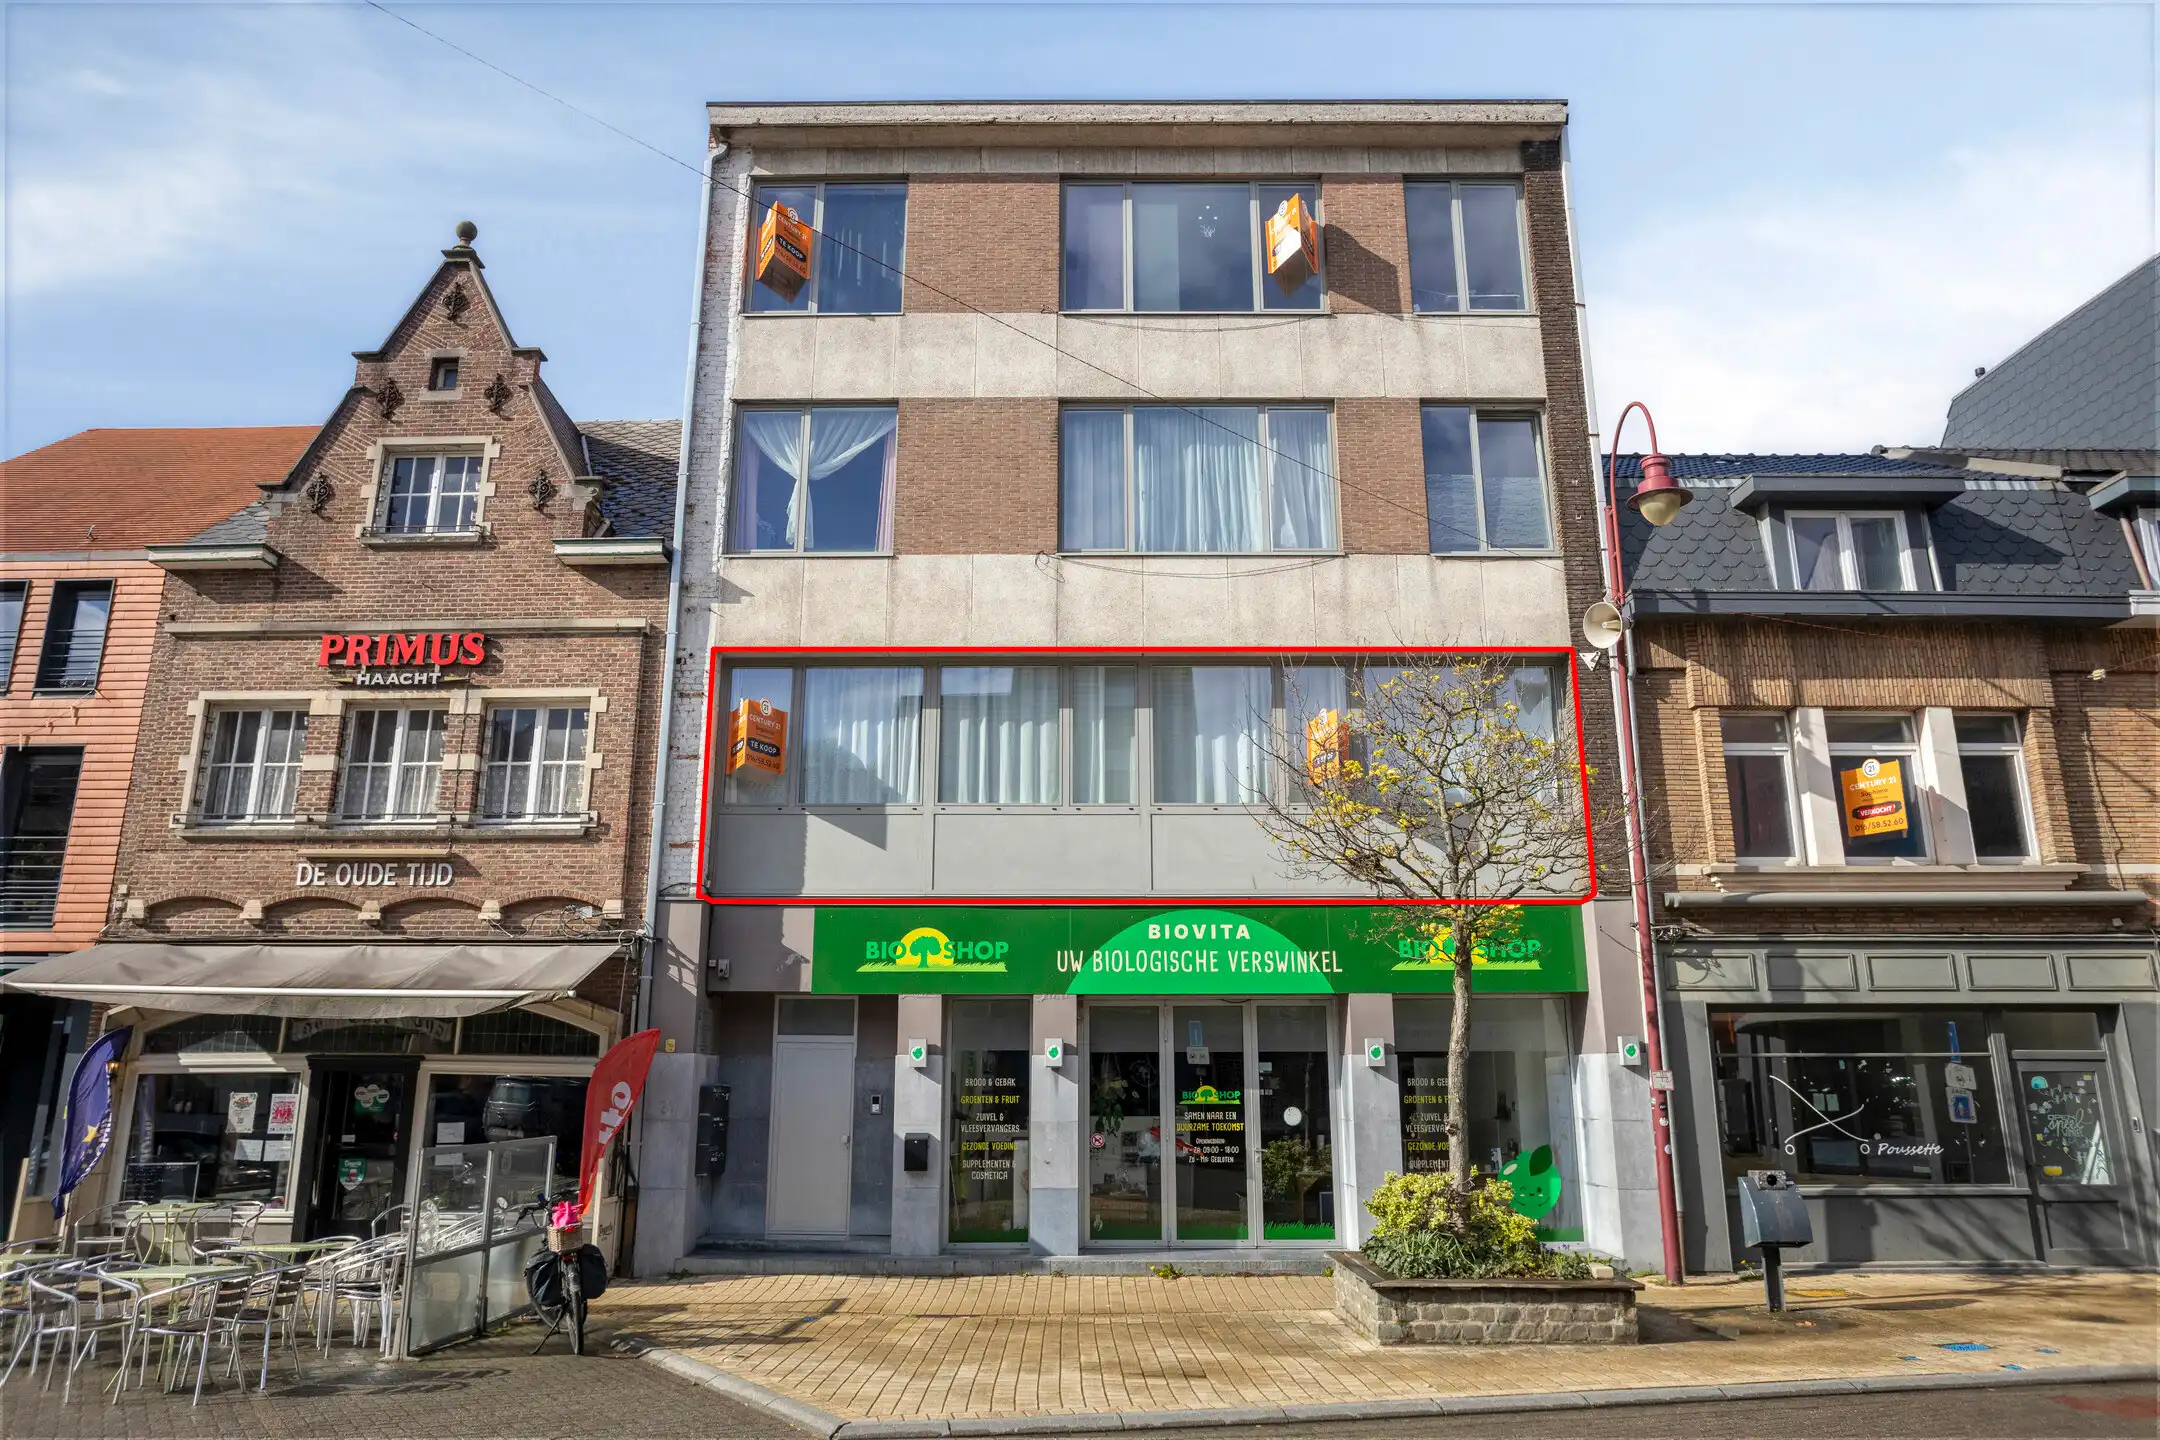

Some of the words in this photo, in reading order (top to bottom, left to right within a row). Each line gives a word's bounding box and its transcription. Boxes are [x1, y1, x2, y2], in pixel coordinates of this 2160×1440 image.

[780, 238, 786, 248] TE
[788, 244, 804, 259] KOOP
[316, 632, 487, 667] PRIMUS
[356, 672, 442, 686] HAACHT
[749, 714, 775, 729] CENTURY
[750, 740, 758, 749] TE
[760, 744, 777, 754] KOOP
[1849, 778, 1887, 791] CENTURY
[1888, 776, 1897, 785] 21
[1860, 805, 1893, 817] VERKOCHT
[1854, 817, 1904, 832] 016/58.52.60
[296, 862, 328, 887] DE
[335, 862, 399, 887] OUDE
[406, 862, 454, 887] TIJD
[1148, 924, 1251, 940] BIOVITA
[866, 940, 907, 960] BIO
[943, 940, 1010, 960] SHOP
[1398, 939, 1439, 959] BIO
[1057, 950, 1084, 973] UW
[1093, 950, 1219, 973] BIOLOGISCHE
[1227, 950, 1343, 973] VERSWINKEL
[965, 1078, 987, 1087] BROOD
[995, 1078, 1016, 1087] GEBAK
[1407, 1078, 1429, 1087] BROOD
[960, 1095, 993, 1104] GROENTEN
[1001, 1095, 1020, 1104] FRUIT
[1182, 1090, 1200, 1100] BIO
[1214, 1090, 1241, 1100] SHOP
[1404, 1095, 1437, 1104] GROENTEN
[975, 1112, 998, 1122] ZUIVEL
[1184, 1111, 1205, 1120] SAMEN
[1206, 1111, 1224, 1120] NAAR
[1225, 1111, 1237, 1120] EEN
[1420, 1113, 1442, 1122] ZUIVEL
[960, 1124, 1020, 1133] VLEESVERVANGERS
[1176, 1122, 1210, 1132] DUURZAME
[1212, 1122, 1245, 1132] TOEKOMST
[961, 1142, 990, 1151] GEZONDE
[1408, 1142, 1436, 1151] GEZONDE
[1877, 1142, 1945, 1156] Poussette
[962, 1160, 1010, 1168] SUPPLEMENTEN
[972, 1171, 1008, 1180] COSMETICA
